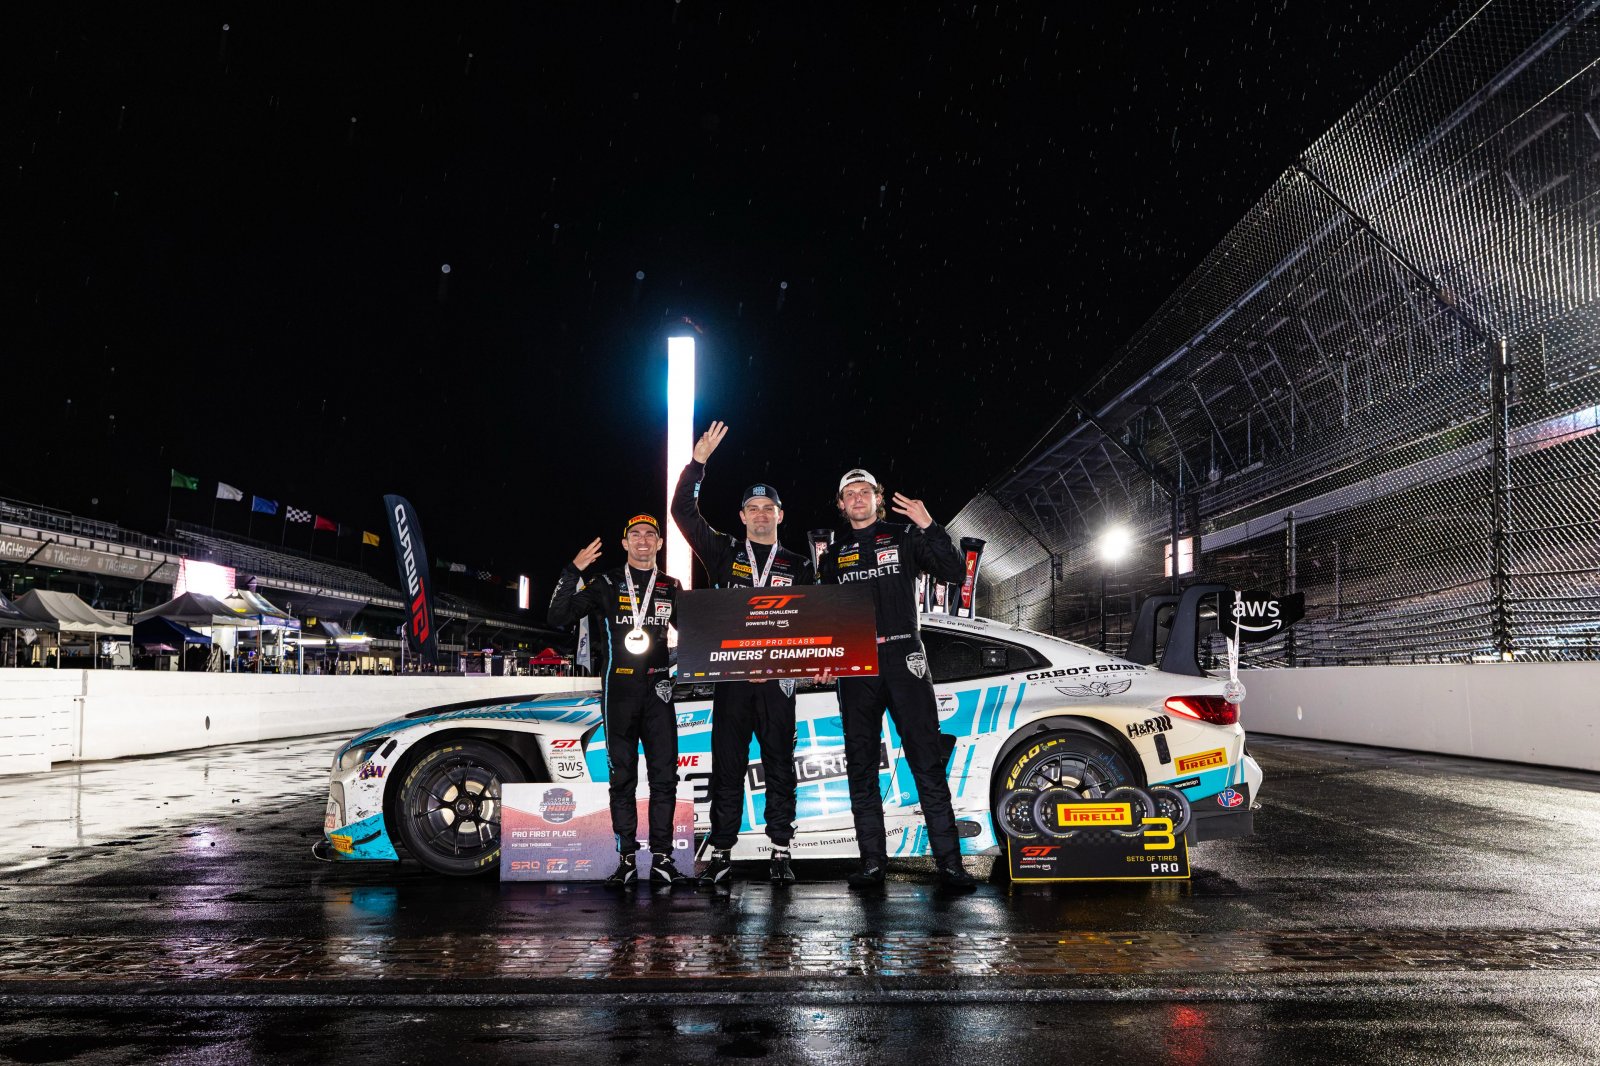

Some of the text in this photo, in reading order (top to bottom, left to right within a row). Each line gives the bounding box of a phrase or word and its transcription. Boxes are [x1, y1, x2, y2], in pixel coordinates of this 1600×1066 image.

[837, 564, 900, 584] LATICRETE
[1232, 600, 1280, 617] aws
[770, 647, 844, 659] CHAMPIONS
[1026, 664, 1147, 681] CABOT GUNS
[1126, 718, 1156, 738] H&R
[557, 761, 583, 771] aws
[677, 756, 699, 767] WE
[1006, 744, 1041, 790] ZERO
[1178, 751, 1223, 771] PIRELLI
[1218, 789, 1235, 807] VP
[1063, 808, 1124, 822] PIRELLI
[885, 826, 904, 838] tems
[1142, 817, 1176, 850] 3
[511, 861, 540, 870] SRO
[1150, 863, 1179, 873] PRO
